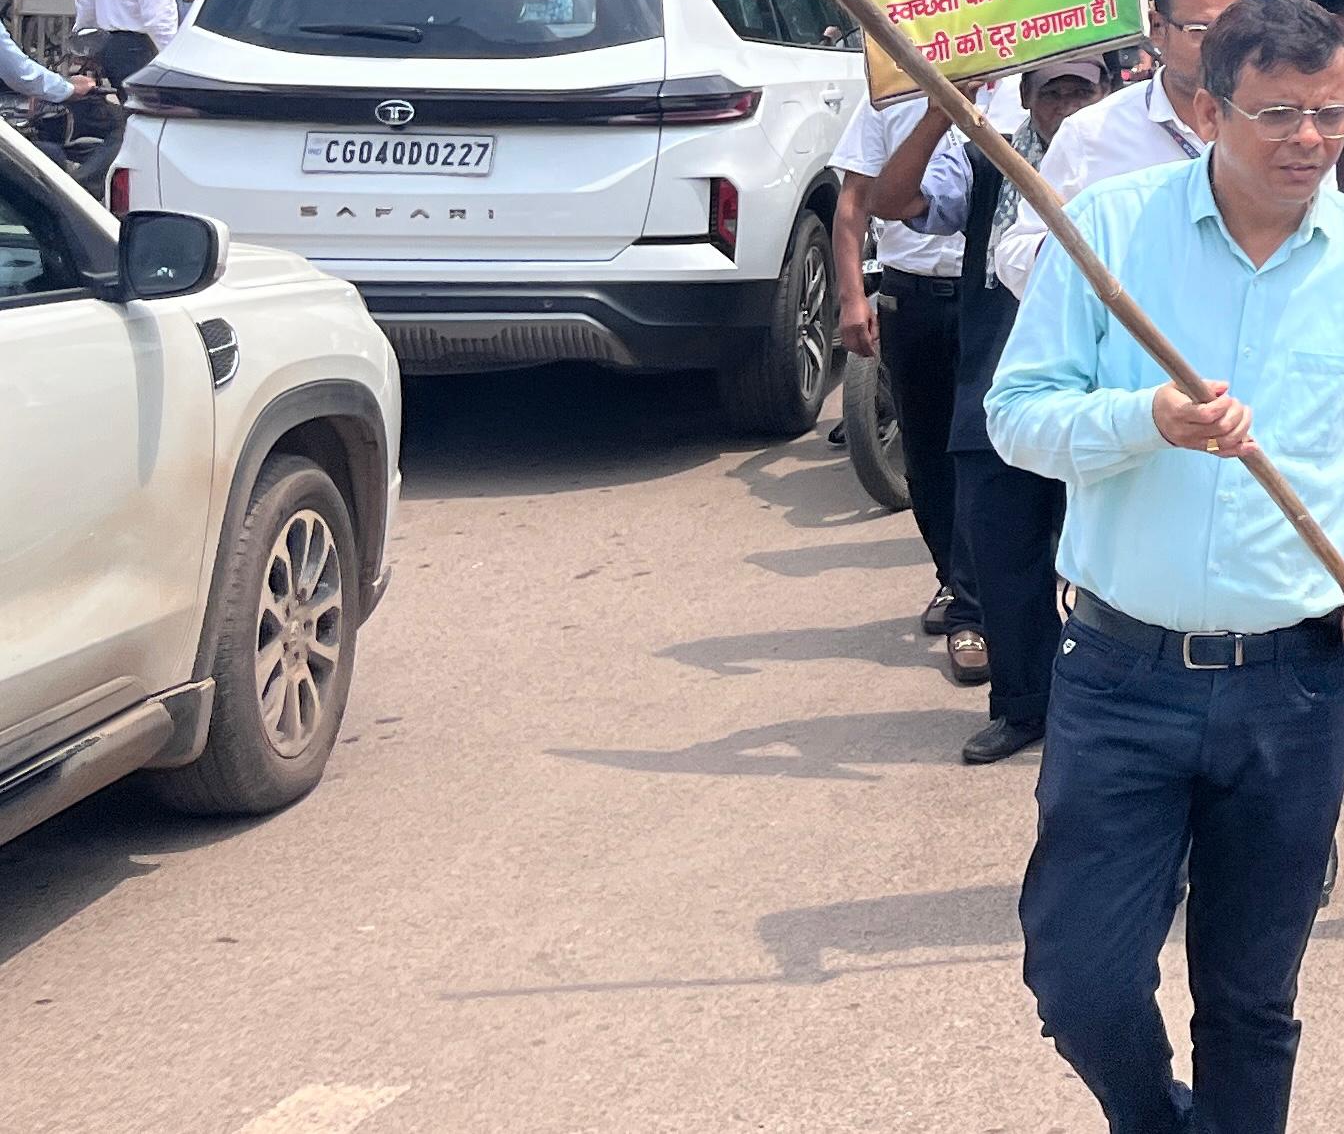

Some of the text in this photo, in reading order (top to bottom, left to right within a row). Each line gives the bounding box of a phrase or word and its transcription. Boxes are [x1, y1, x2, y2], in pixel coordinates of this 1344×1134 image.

[955, 24, 984, 56] को
[988, 22, 1018, 59] दूर
[1021, 6, 1086, 40] भगाना
[325, 140, 490, 167] CG04QD0227
[300, 206, 494, 220] SAFARI
